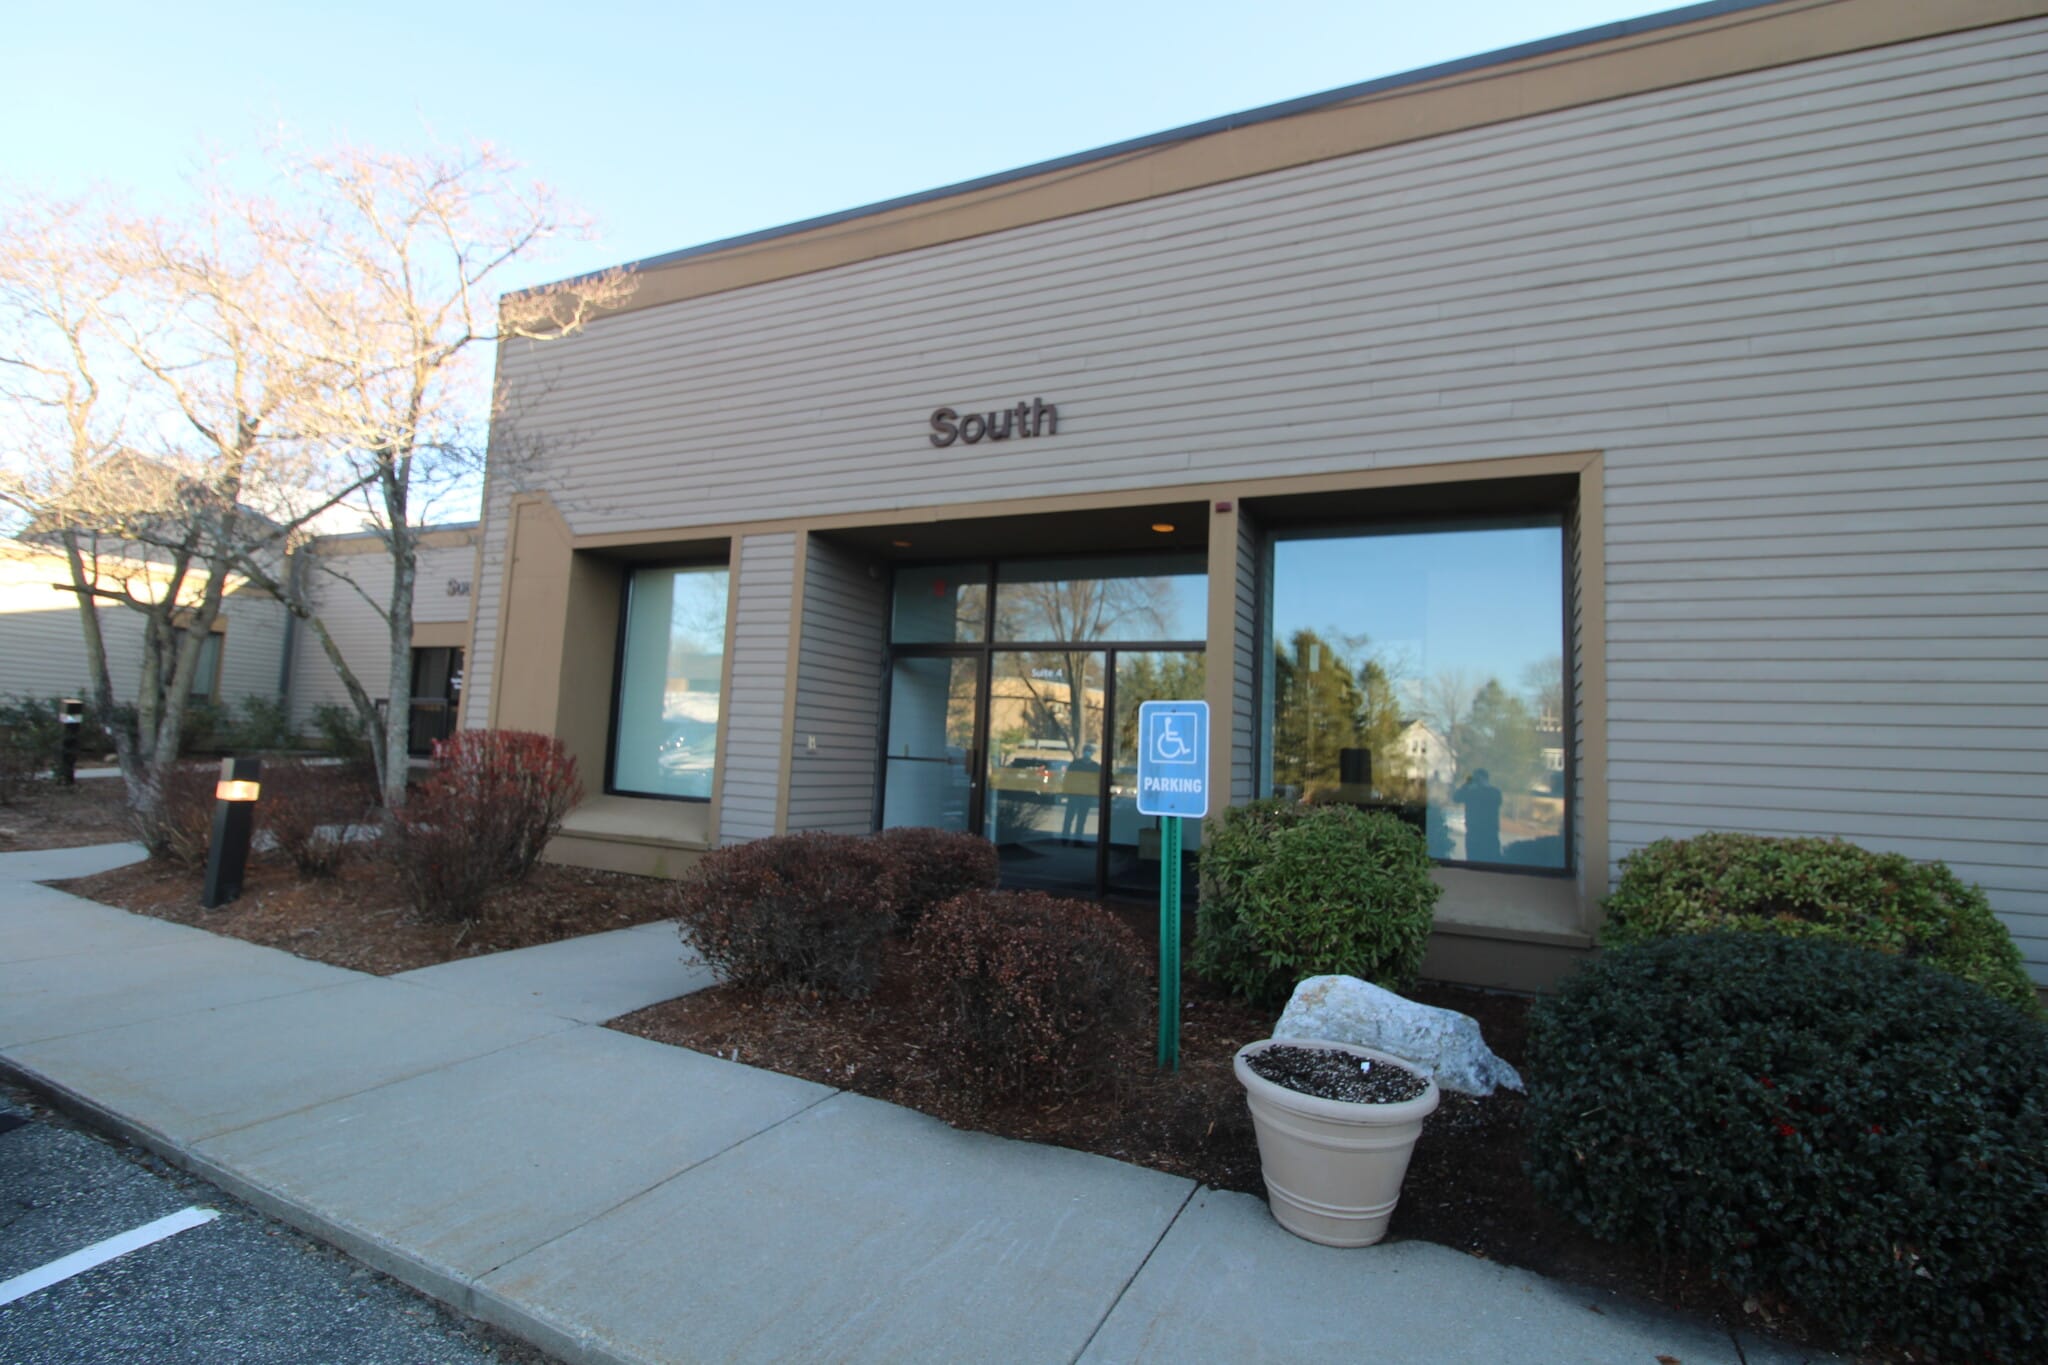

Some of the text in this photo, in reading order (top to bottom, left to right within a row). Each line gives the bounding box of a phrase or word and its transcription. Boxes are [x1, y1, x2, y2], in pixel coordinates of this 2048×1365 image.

[929, 397, 1057, 448] South
[1031, 667, 1054, 679] Suite
[1143, 776, 1202, 793] PARKING
